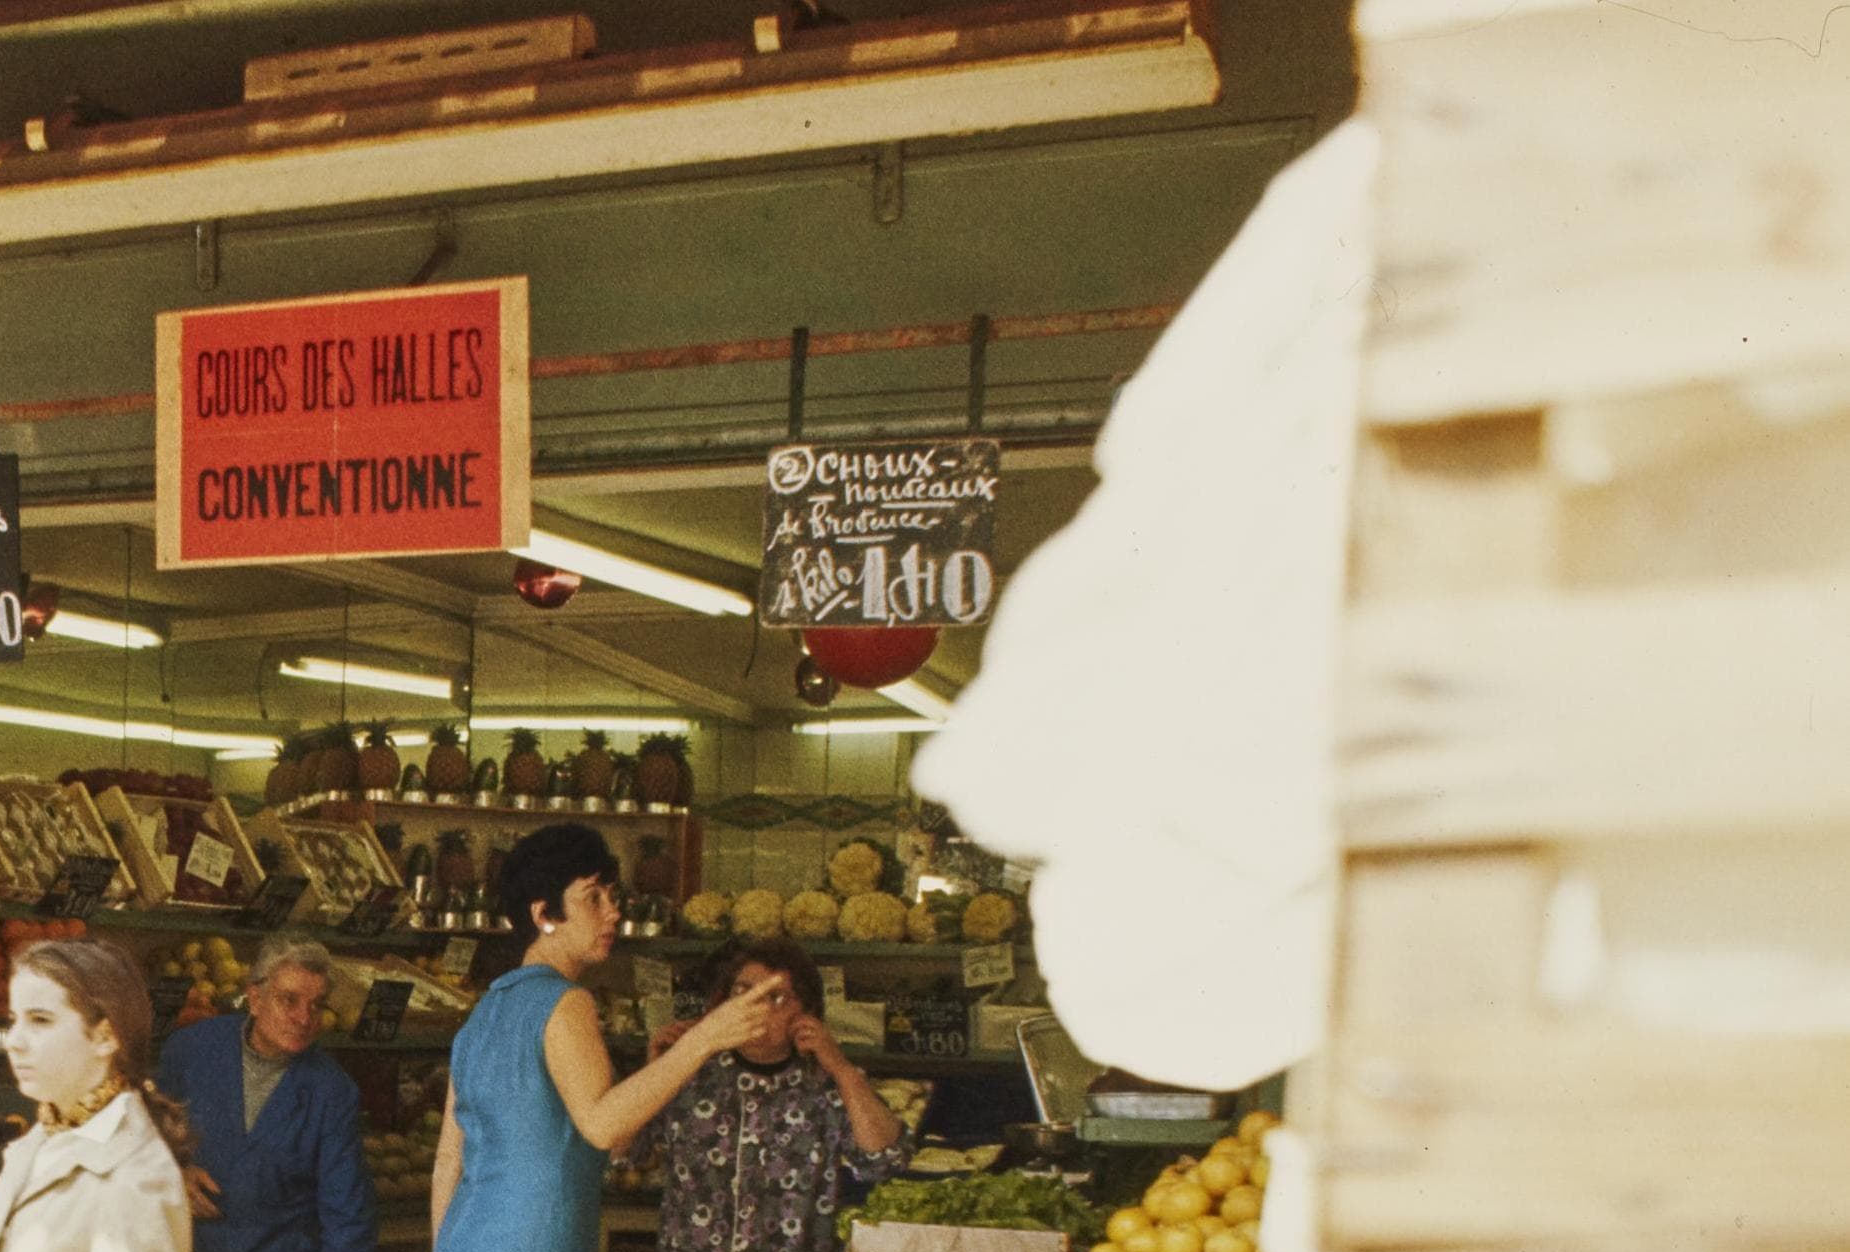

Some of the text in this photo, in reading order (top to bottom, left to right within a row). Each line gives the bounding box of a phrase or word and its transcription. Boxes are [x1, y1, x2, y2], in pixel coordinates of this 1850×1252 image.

[197, 326, 484, 419] COURS DES HALLES
